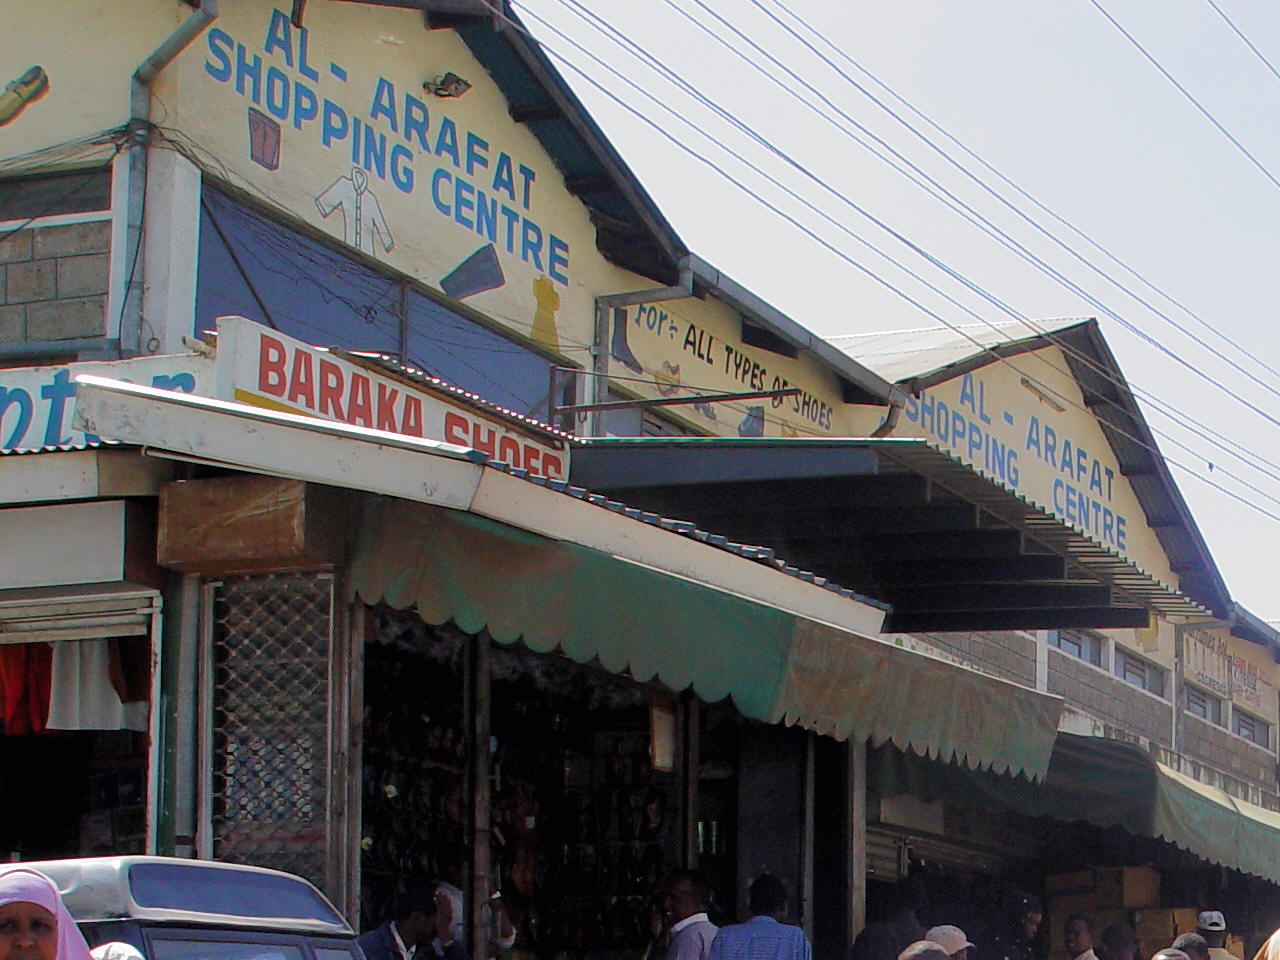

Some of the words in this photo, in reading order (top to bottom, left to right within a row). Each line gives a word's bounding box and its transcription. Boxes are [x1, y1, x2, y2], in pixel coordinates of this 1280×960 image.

[204, 28, 414, 193] SHOPPING
[431, 168, 569, 287] CENTRE
[370, 77, 535, 211] ARAFAT
[258, 332, 424, 438] BARAKA
[683, 323, 714, 366] ALL
[725, 345, 766, 392] TYPES
[792, 389, 833, 431] SHOES
[904, 391, 1020, 488] SHOPPING
[1052, 478, 1127, 551] CENTRE
[1025, 416, 1114, 501] ARAFAT
